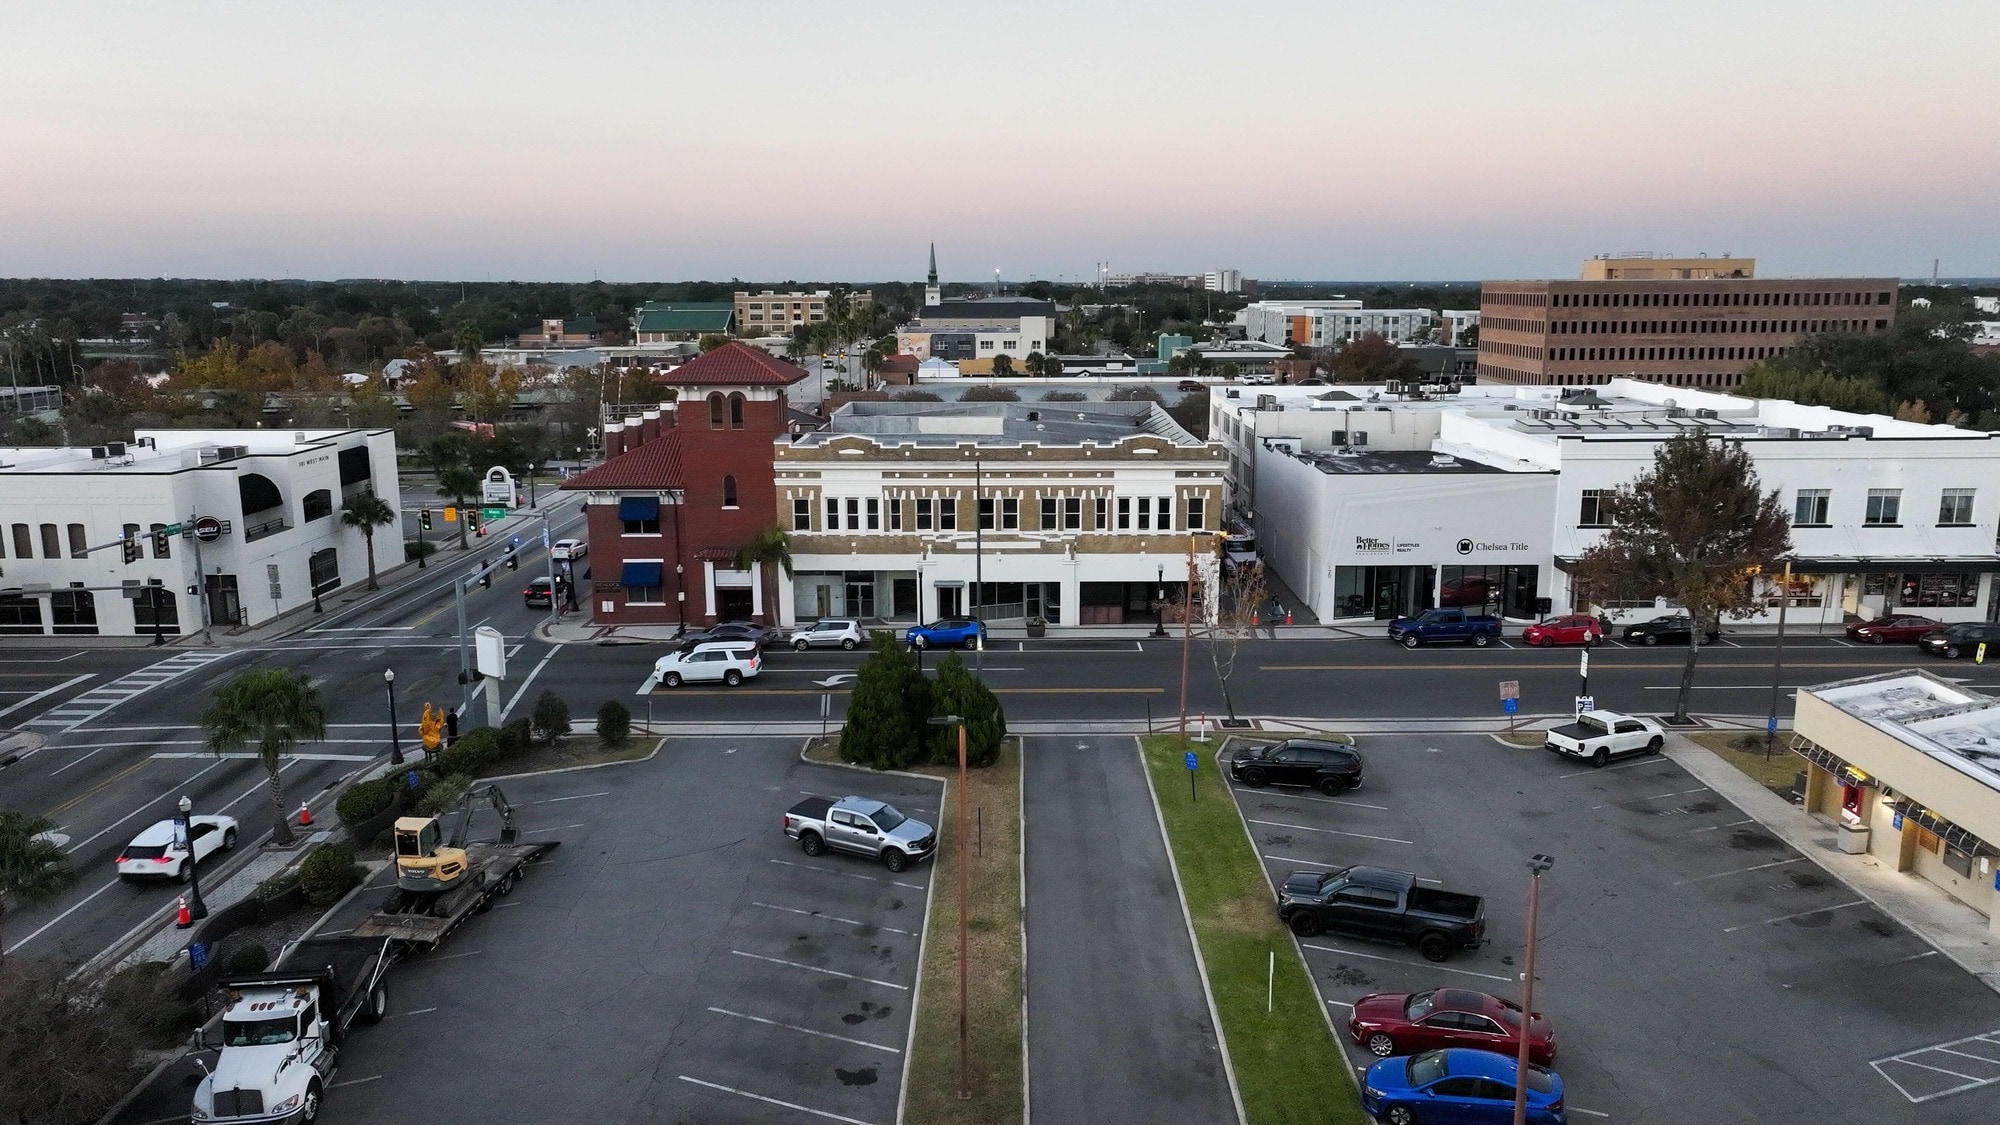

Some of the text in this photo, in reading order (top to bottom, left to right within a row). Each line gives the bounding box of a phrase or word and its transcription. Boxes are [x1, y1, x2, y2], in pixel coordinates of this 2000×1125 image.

[1356, 536, 1379, 544] Better
[1363, 541, 1390, 550] Homes
[1475, 542, 1529, 551] Chelsea Title
[1503, 686, 1518, 694] STOP
